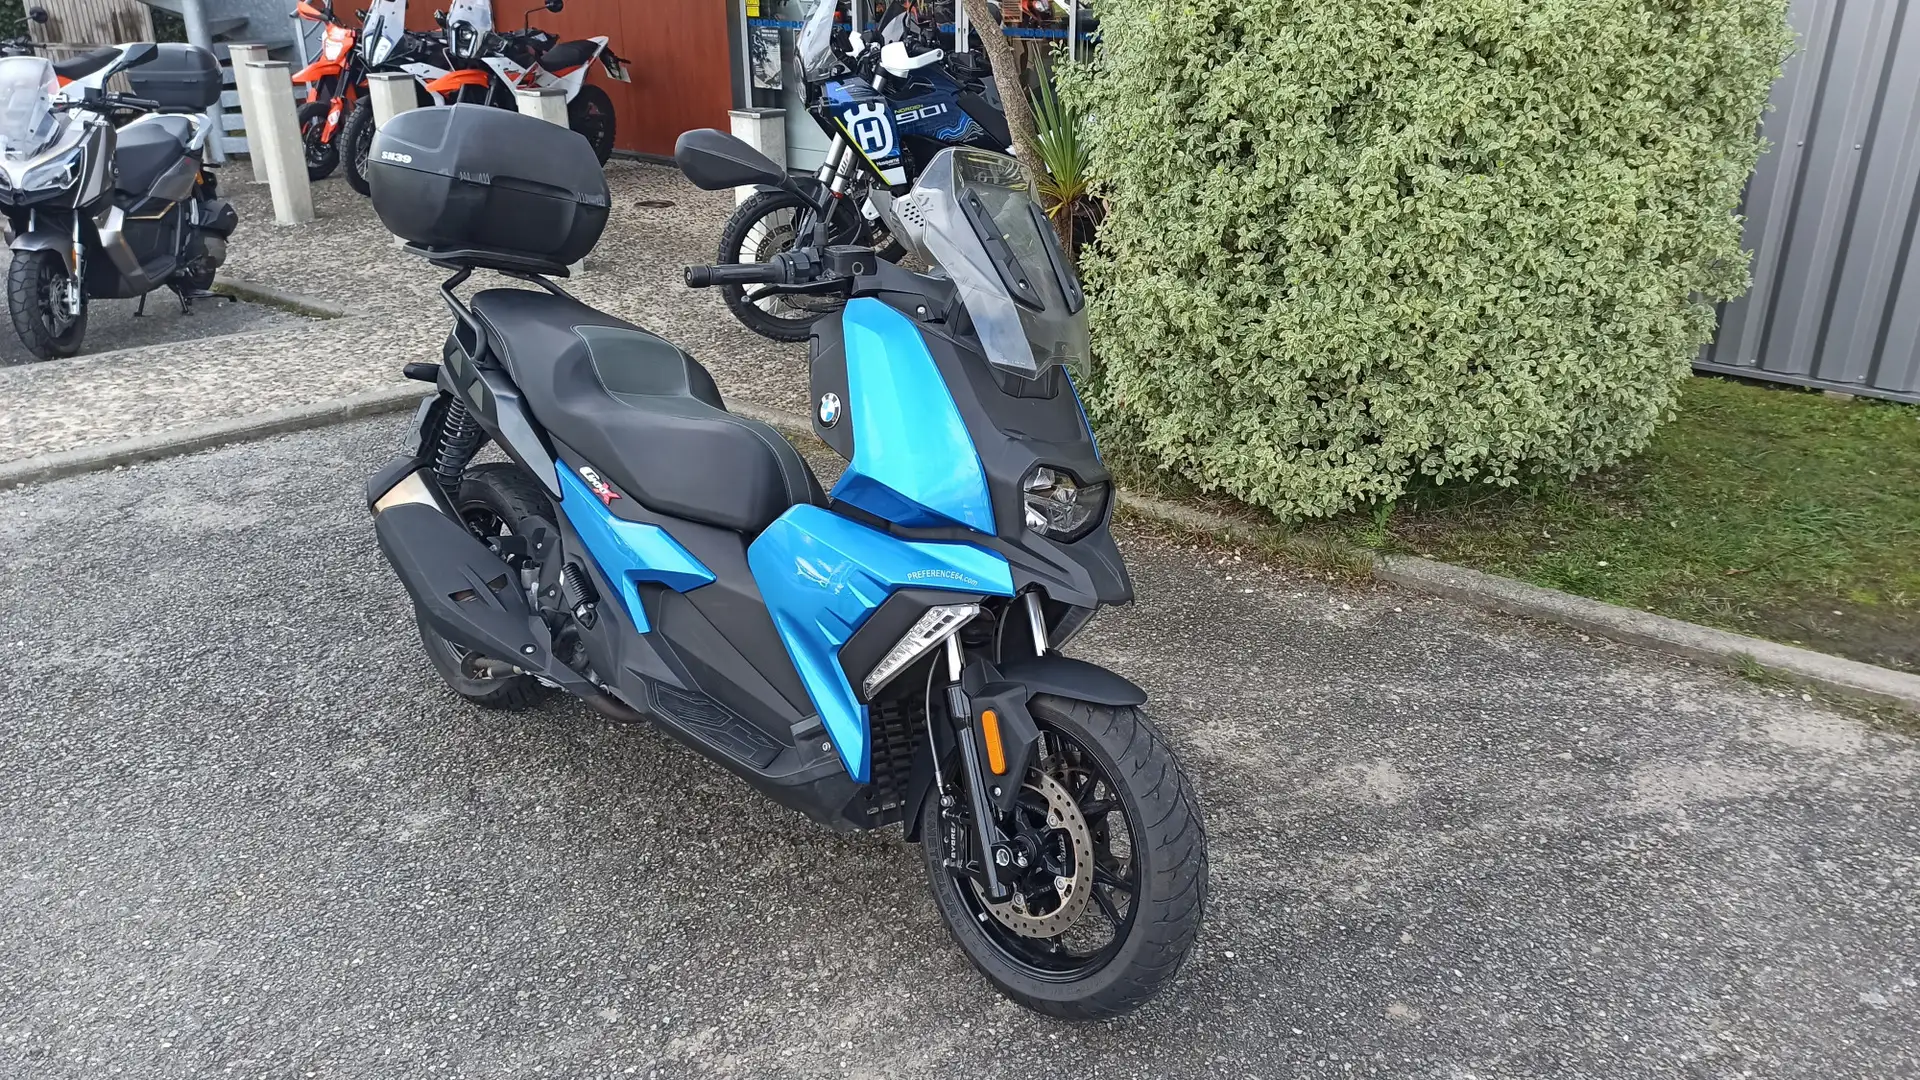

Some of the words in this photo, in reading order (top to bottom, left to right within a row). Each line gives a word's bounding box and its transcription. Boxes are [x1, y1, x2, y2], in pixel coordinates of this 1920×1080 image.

[895, 102, 948, 125] 901
[381, 151, 412, 163] SH39
[907, 569, 978, 587] PREFERENCE64.com
